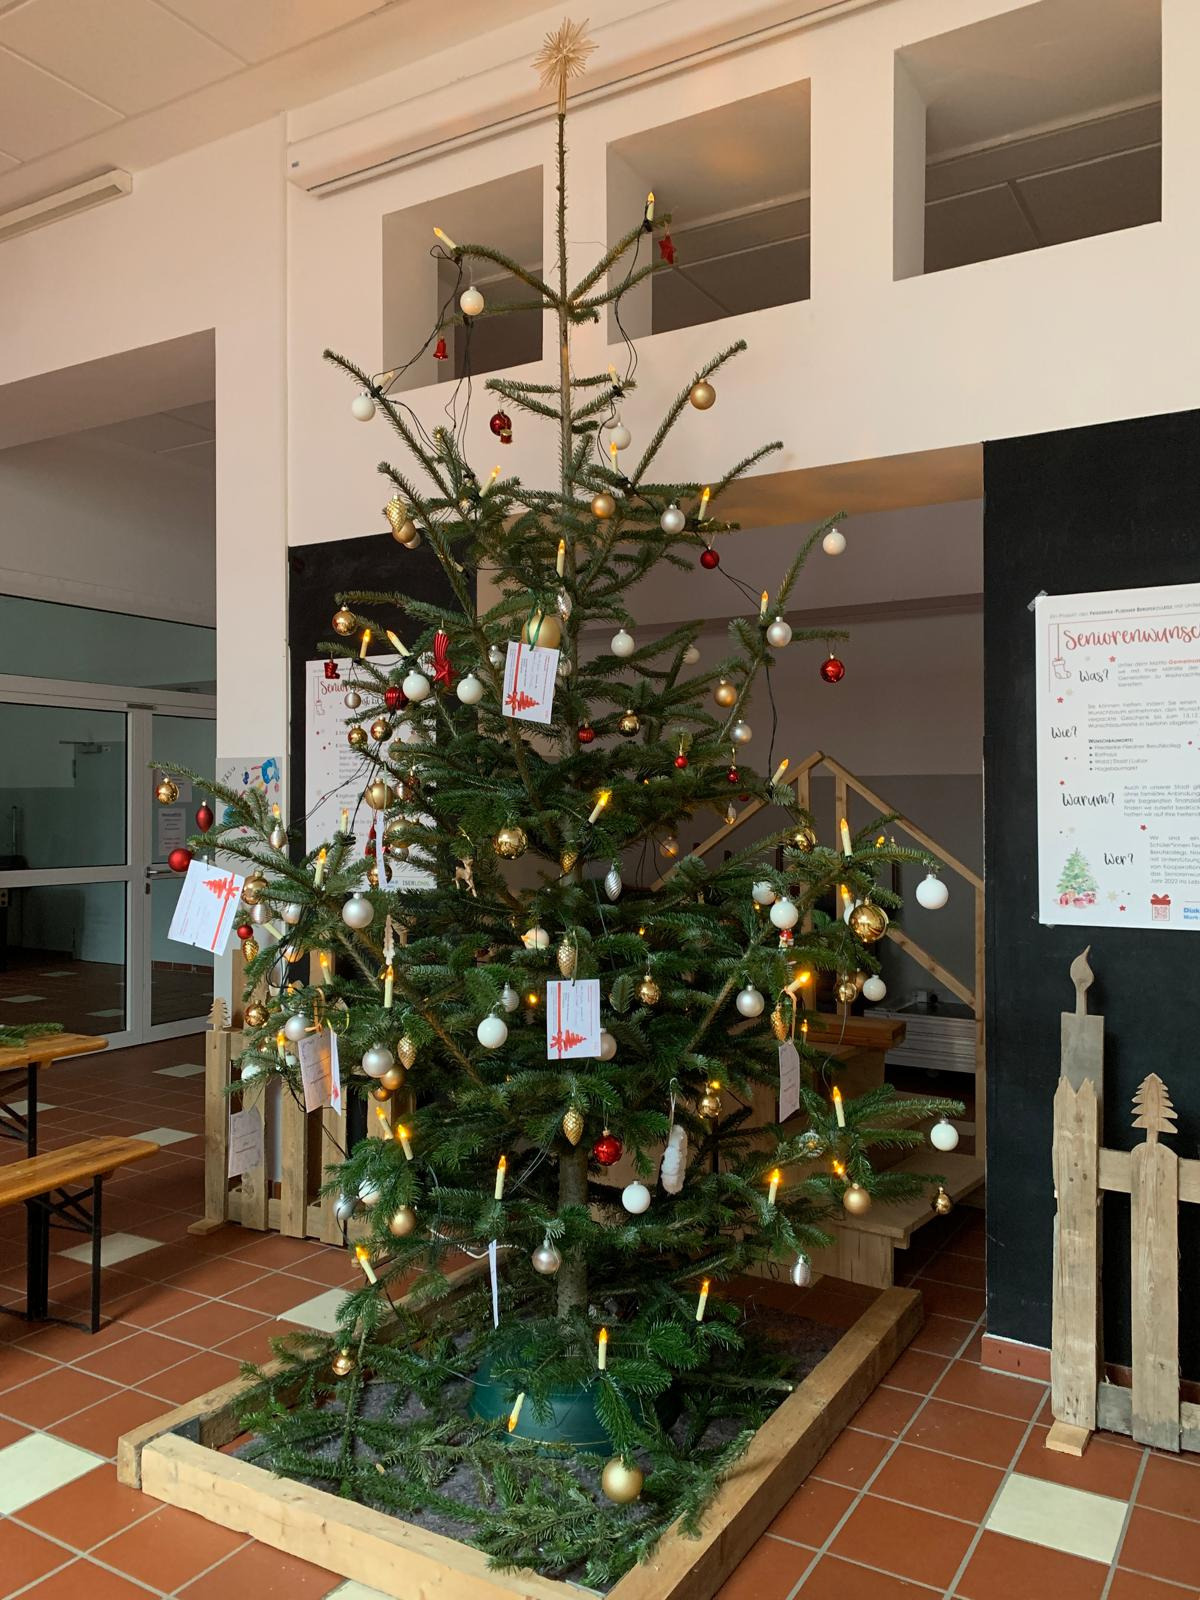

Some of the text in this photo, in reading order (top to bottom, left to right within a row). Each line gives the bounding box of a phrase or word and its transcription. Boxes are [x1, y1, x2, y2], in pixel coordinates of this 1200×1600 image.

[1079, 669, 1109, 682] Was?
[1051, 725, 1078, 739] Wie?
[1061, 792, 1115, 807] Warum?
[1103, 853, 1134, 866] Wer?
